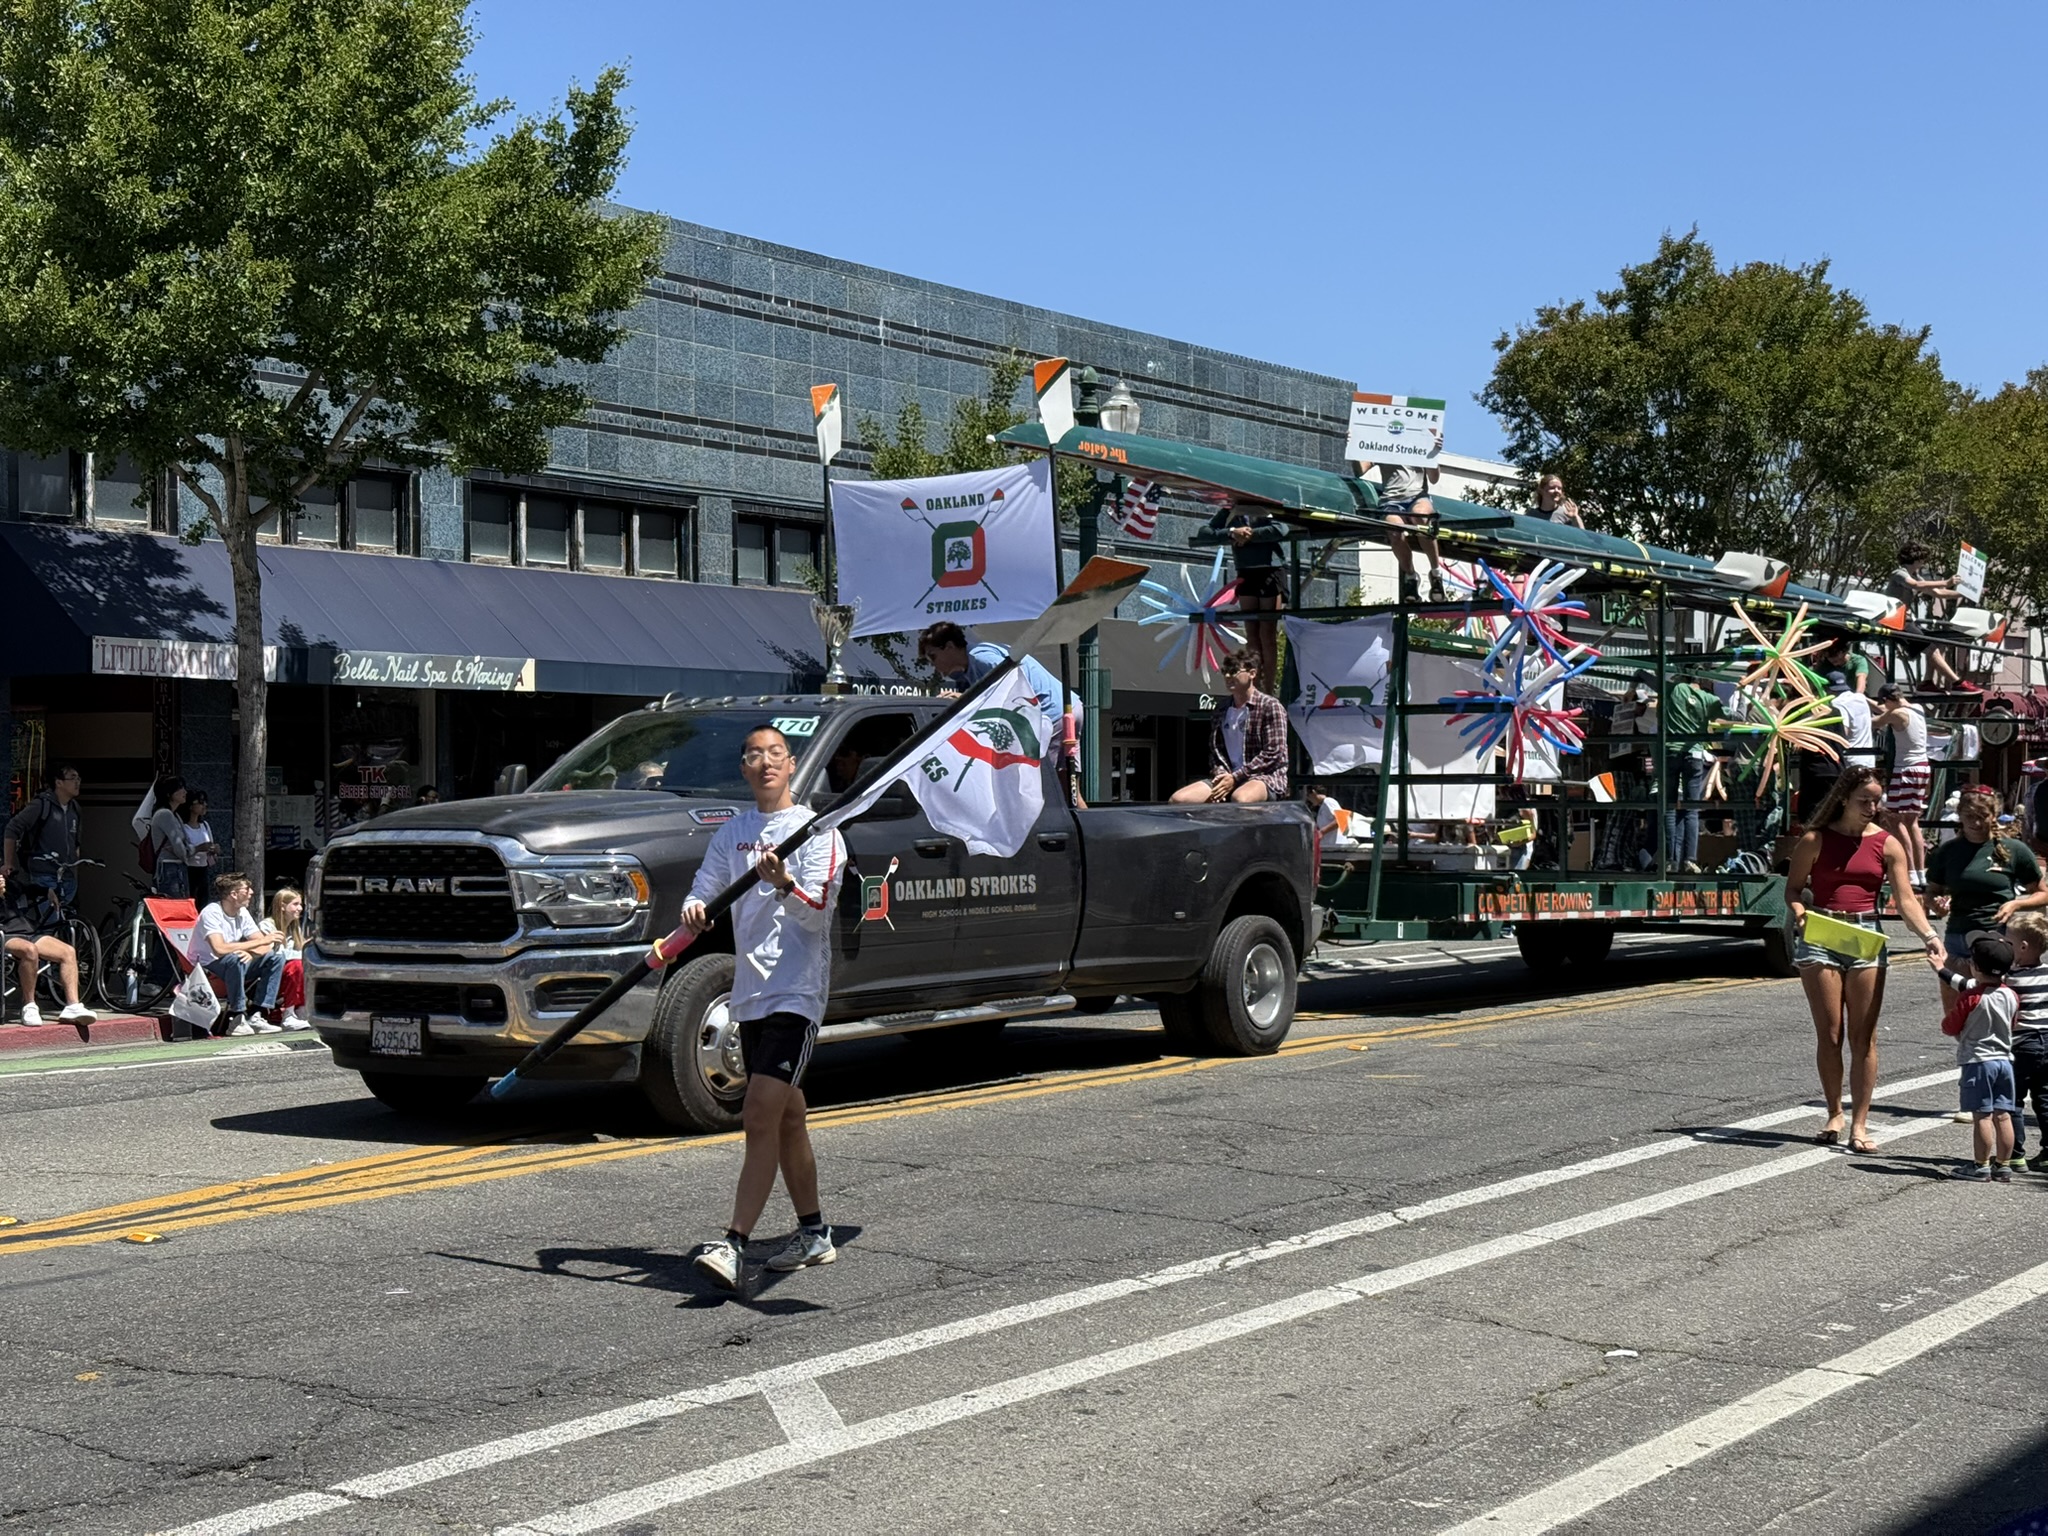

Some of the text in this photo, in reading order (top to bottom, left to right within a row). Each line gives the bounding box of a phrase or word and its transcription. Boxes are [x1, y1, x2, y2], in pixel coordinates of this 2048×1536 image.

[1357, 407, 1438, 422] WELCOME
[1078, 441, 1128, 463] The Gator
[1358, 440, 1427, 455] Oakland Strokes
[926, 493, 985, 510] OAKLAND
[926, 597, 987, 613] STROKES
[100, 644, 157, 672] LITTLE
[334, 653, 514, 690] Bella Nail Spa & Waxing
[777, 720, 815, 732] 170
[358, 765, 387, 783] TK
[339, 785, 369, 799] BARBER
[370, 785, 390, 799] SHOP
[365, 878, 445, 893] RAM
[895, 874, 1037, 901] OAKLAND STROKES
[1552, 892, 1593, 911] ROWING
[922, 911, 938, 919] HIGH
[939, 909, 963, 917] SCHOOL
[969, 907, 990, 915] MIDDLE
[991, 905, 1014, 914] SCHOOL
